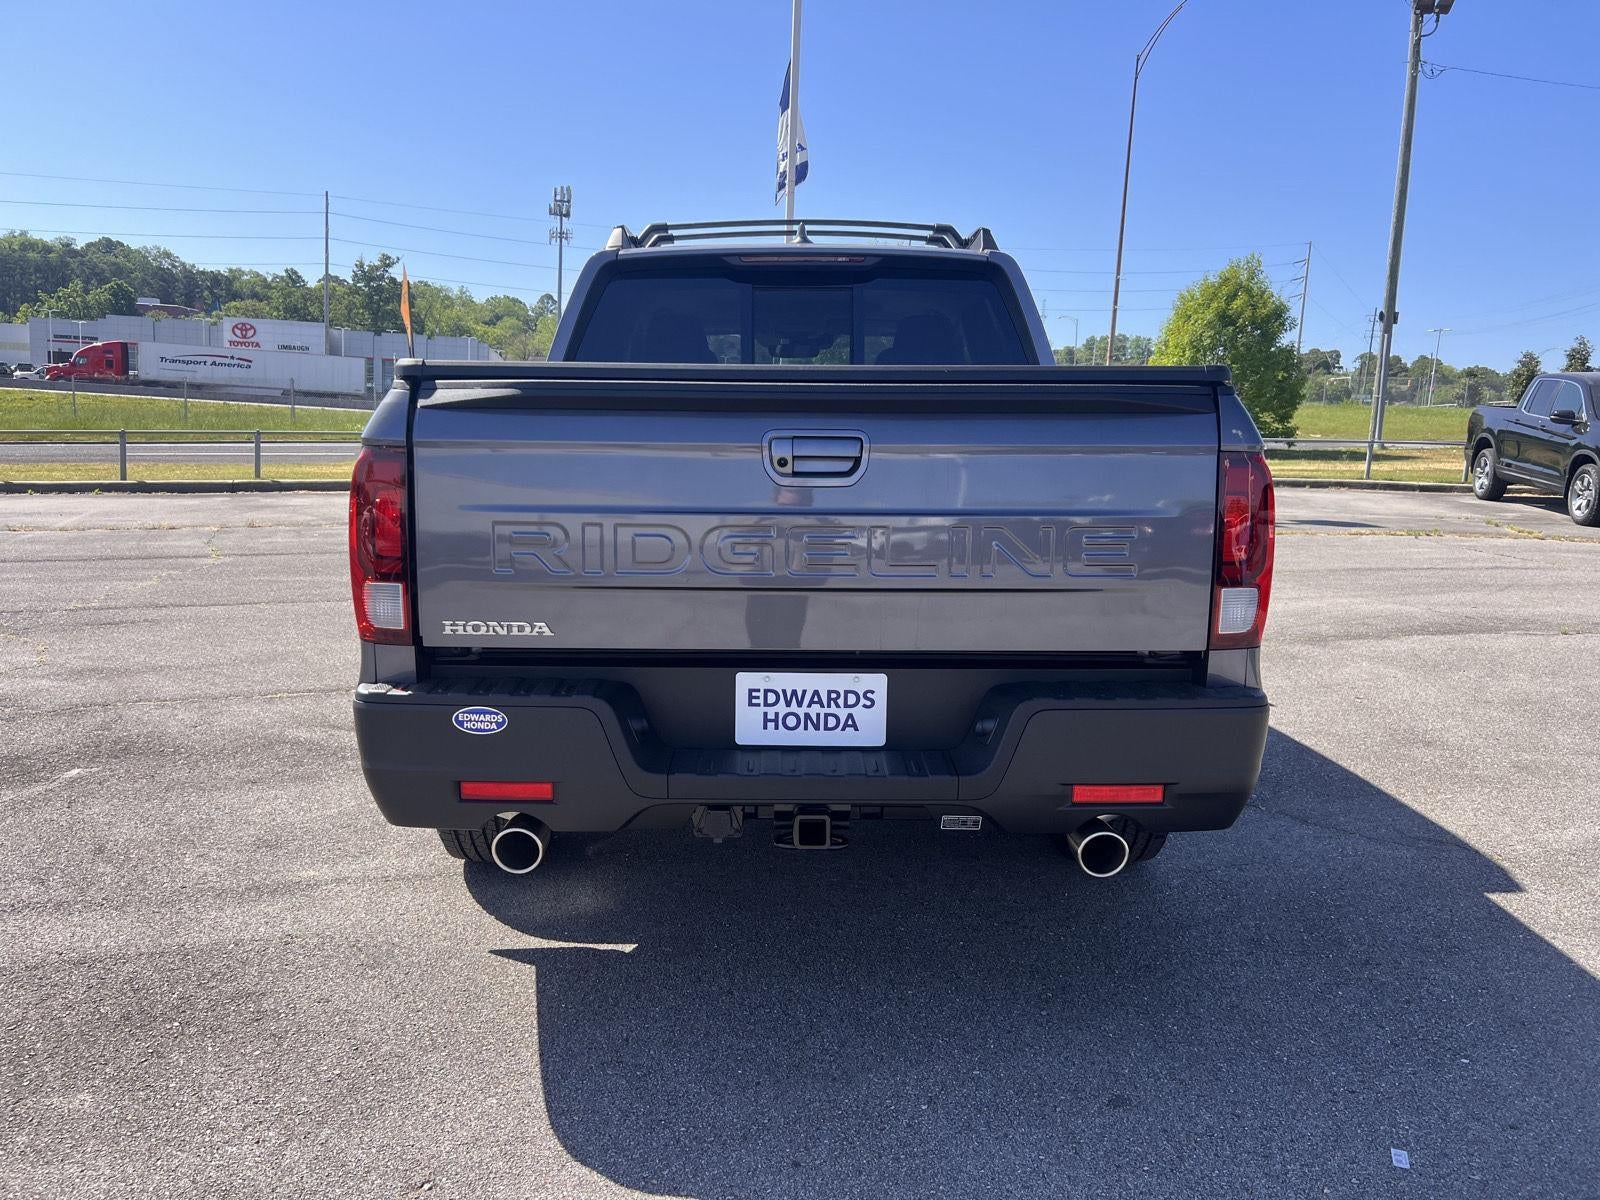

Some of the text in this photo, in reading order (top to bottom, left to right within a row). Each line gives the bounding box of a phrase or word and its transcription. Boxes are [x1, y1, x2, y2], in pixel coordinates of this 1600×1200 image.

[228, 340, 261, 348] TOYOTA
[159, 356, 251, 370] Transport America
[492, 520, 1138, 578] RIDGELINE
[442, 620, 554, 636] HONDA
[747, 688, 876, 709] EDWARDS
[458, 713, 503, 722] EDWARDS
[762, 711, 859, 732] HONDA
[463, 721, 498, 730] HONDA
